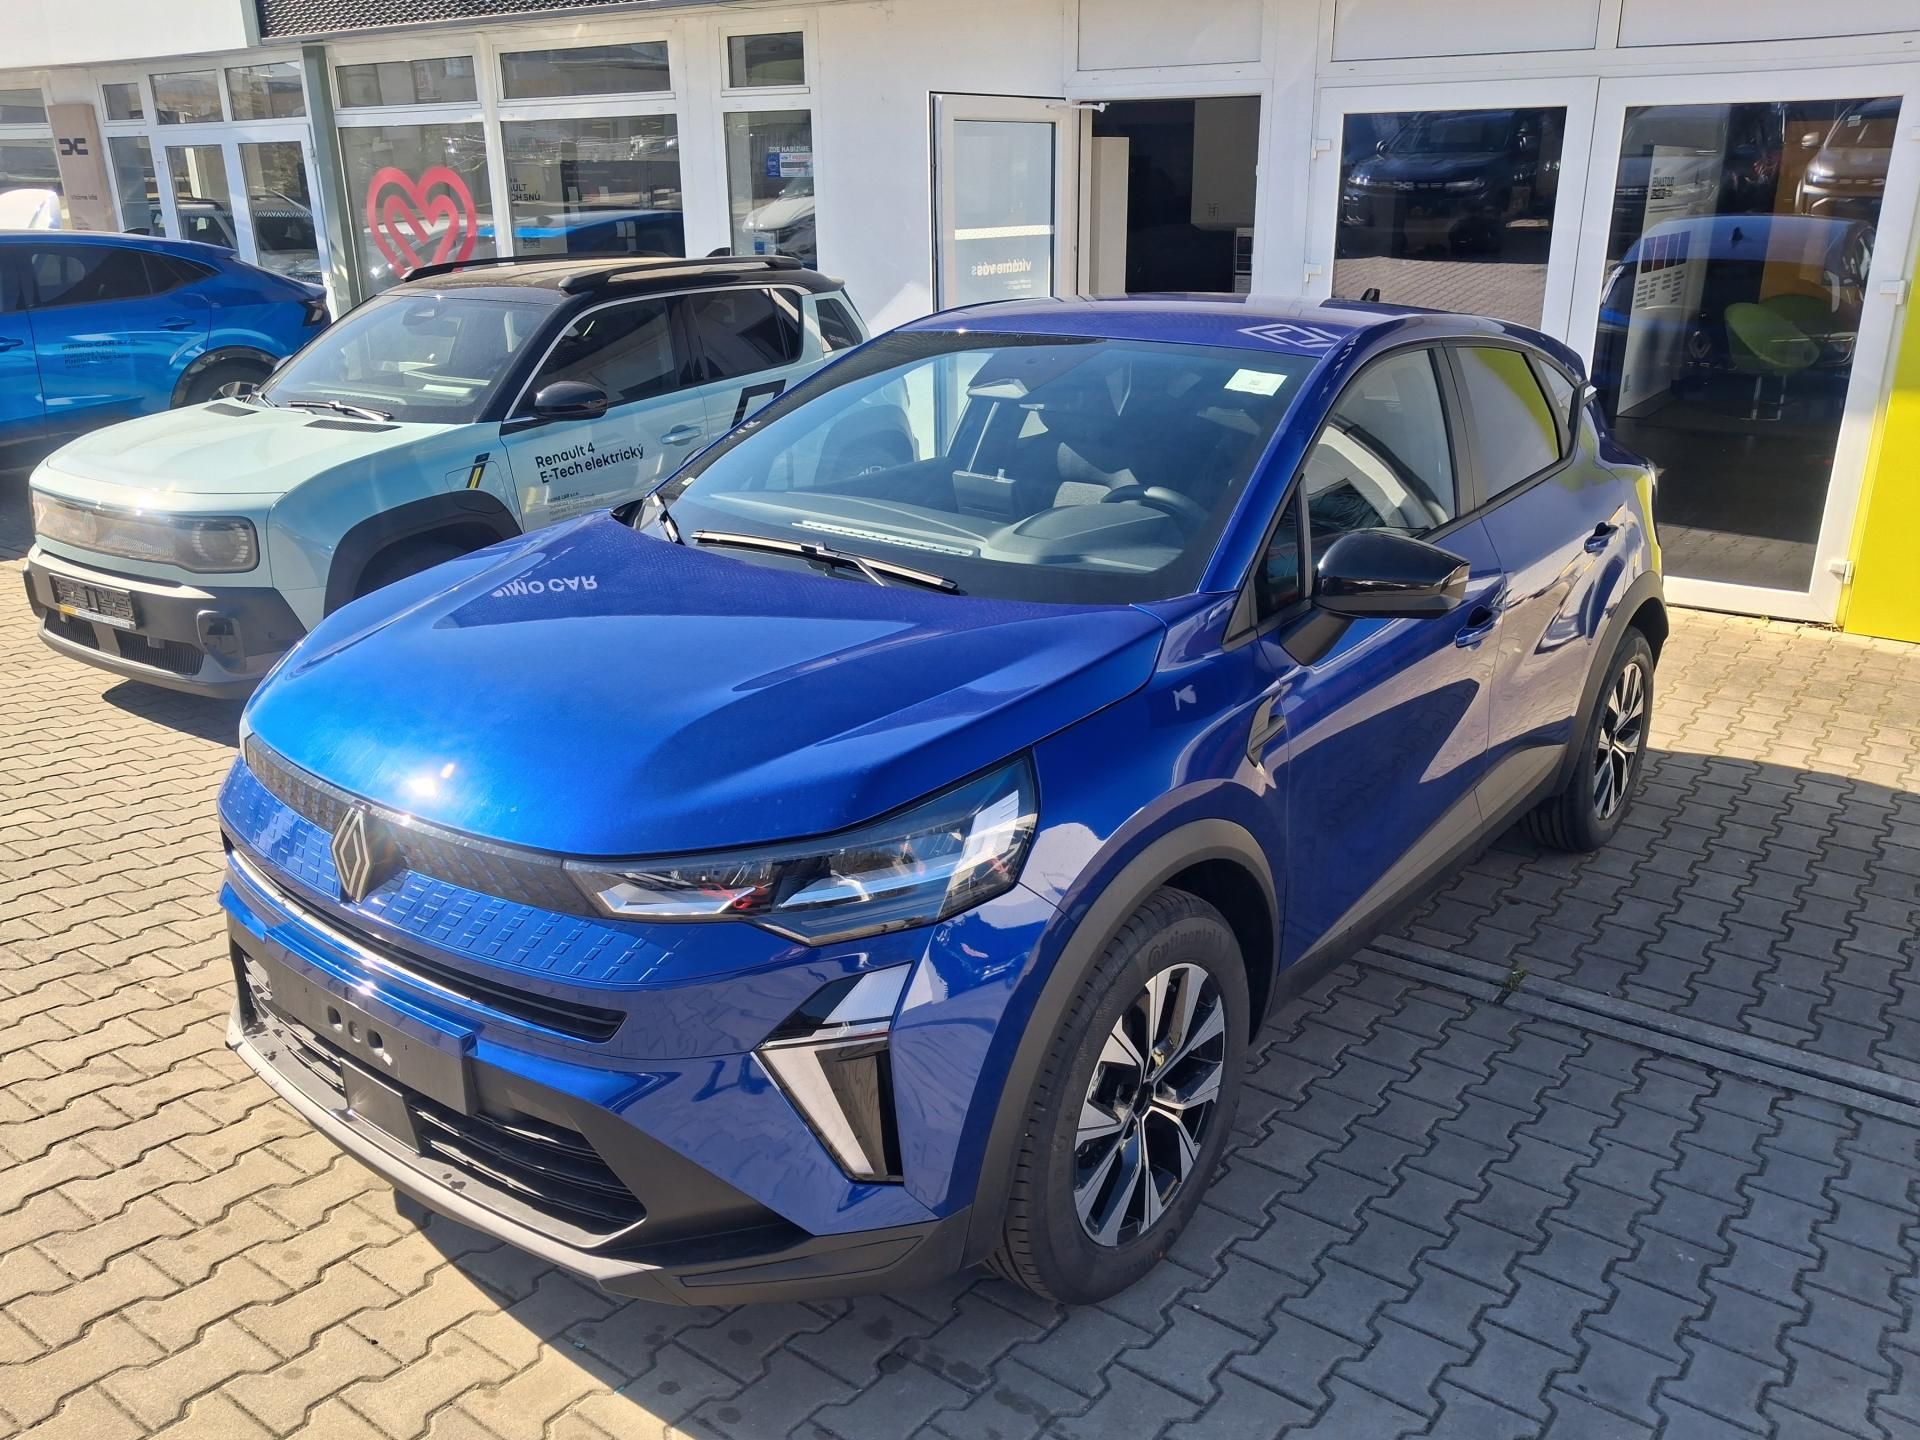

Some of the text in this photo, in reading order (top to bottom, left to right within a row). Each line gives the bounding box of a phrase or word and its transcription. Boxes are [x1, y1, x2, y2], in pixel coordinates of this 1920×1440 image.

[535, 441, 596, 468] Renault 4
[540, 443, 644, 484] E-Tech elektrický
